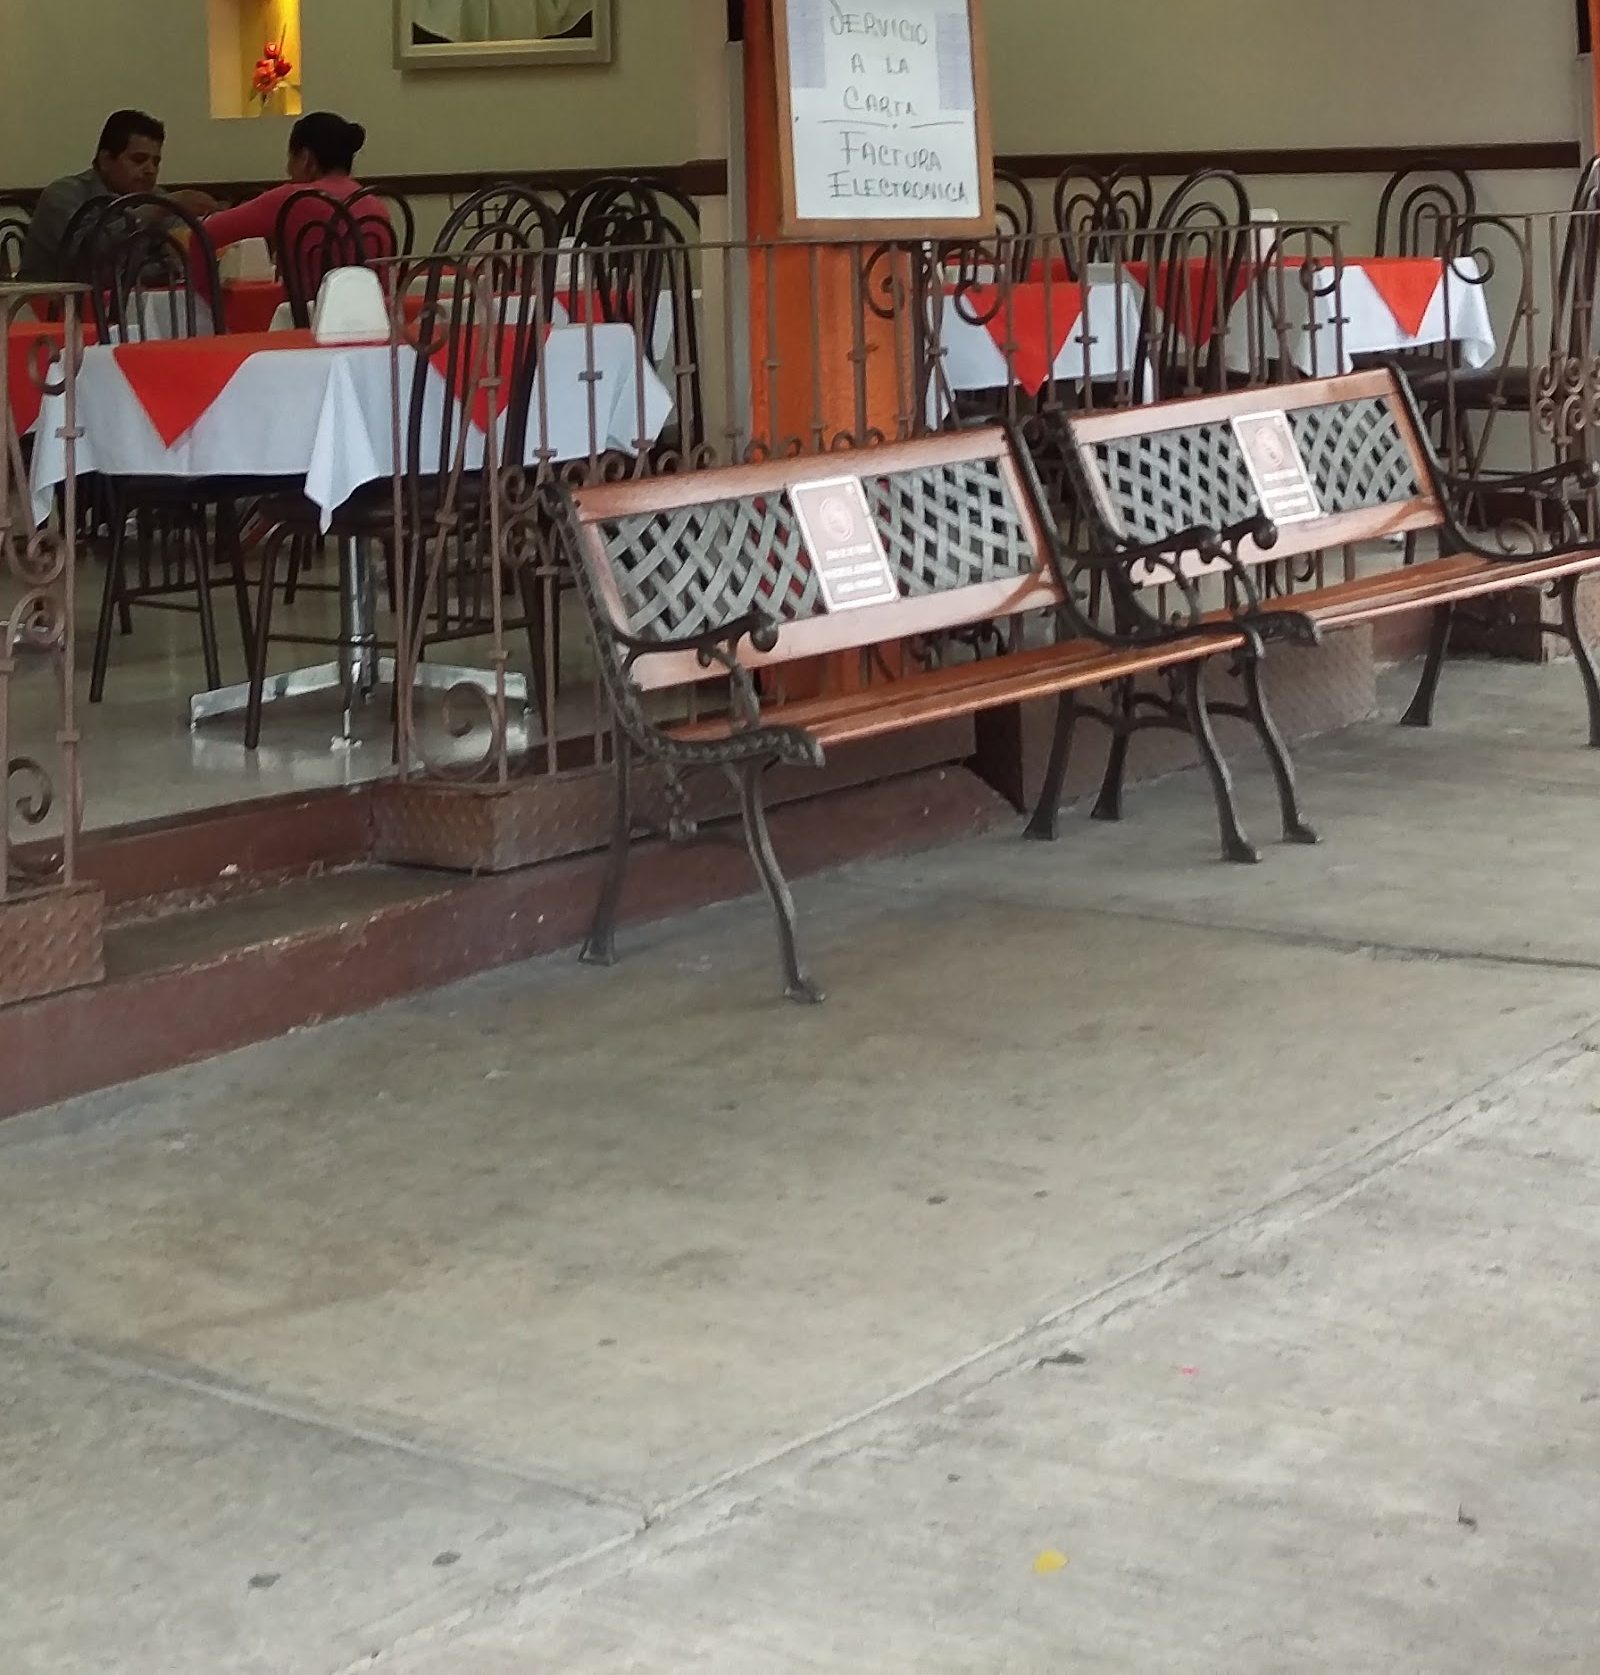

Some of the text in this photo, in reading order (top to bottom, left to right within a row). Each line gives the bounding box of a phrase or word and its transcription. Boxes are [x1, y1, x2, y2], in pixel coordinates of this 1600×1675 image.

[851, 52, 911, 75] A LA
[843, 85, 918, 118] CARTA
[840, 130, 942, 172] FACTURA
